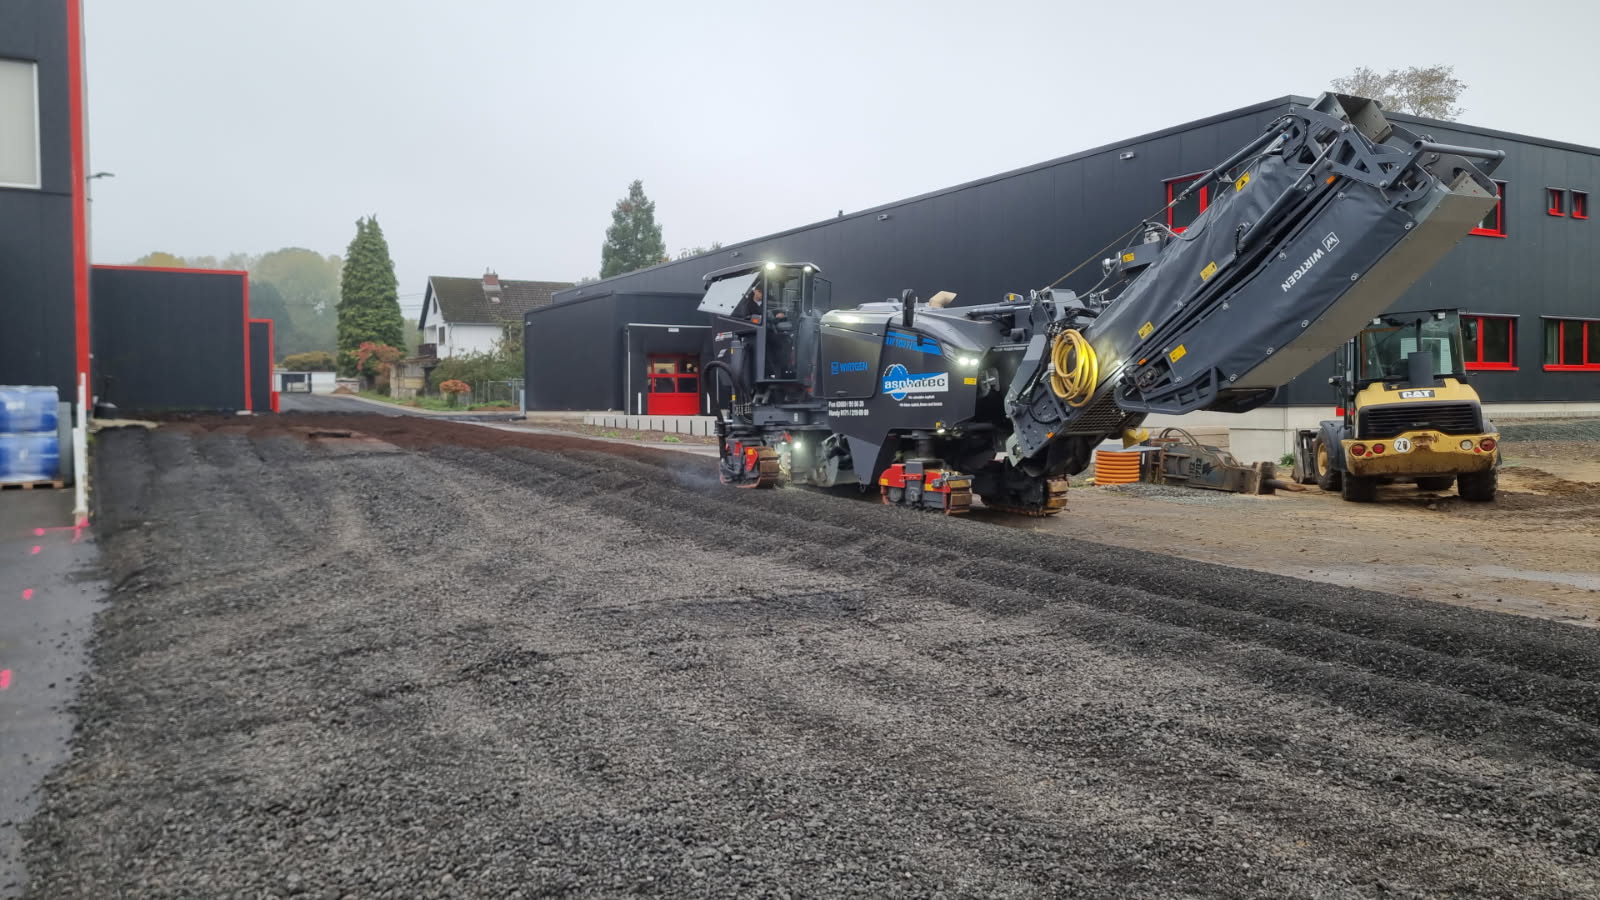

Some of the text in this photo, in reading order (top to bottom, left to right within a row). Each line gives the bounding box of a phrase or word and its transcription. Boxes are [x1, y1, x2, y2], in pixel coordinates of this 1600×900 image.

[1281, 248, 1325, 292] WIRTGEN
[884, 377, 945, 390] asphatec
[1401, 390, 1431, 399] CAT
